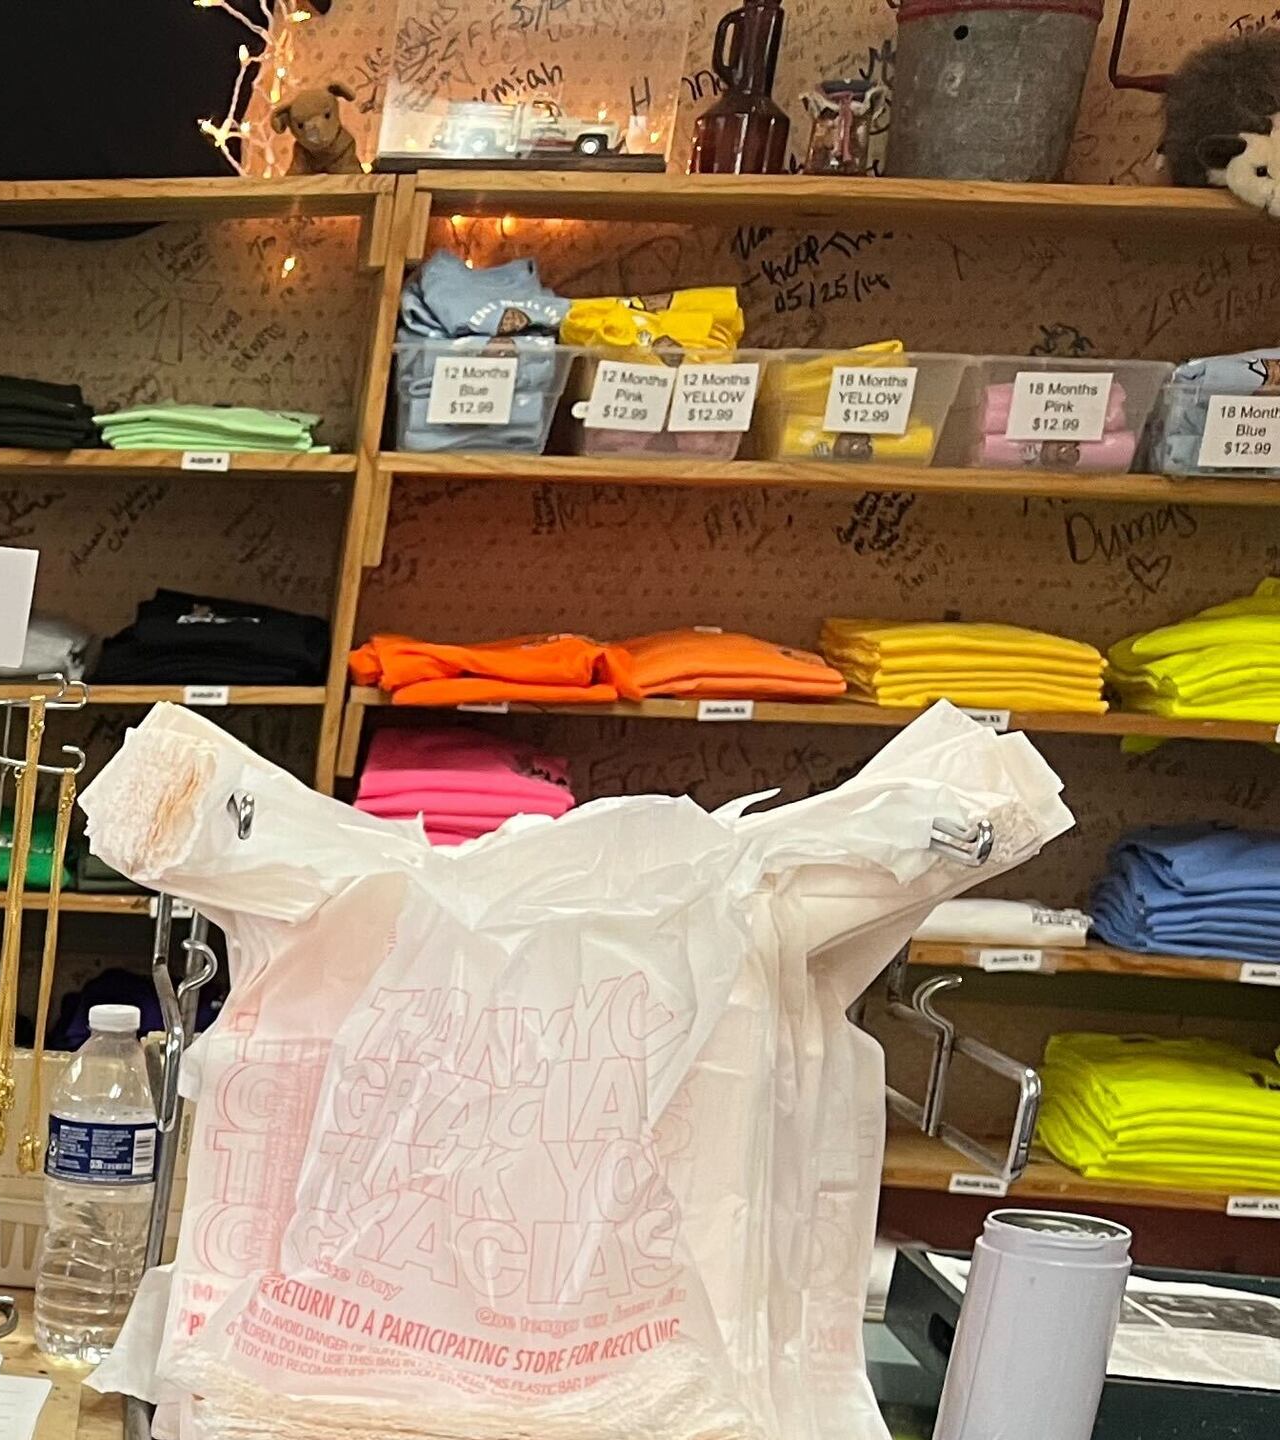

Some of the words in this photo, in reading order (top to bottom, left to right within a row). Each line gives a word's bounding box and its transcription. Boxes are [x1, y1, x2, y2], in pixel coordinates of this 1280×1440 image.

[443, 366, 460, 380] 12
[462, 366, 512, 381] Months
[601, 370, 619, 383] 12
[619, 370, 670, 389] Months
[682, 373, 699, 387] 12
[701, 373, 751, 388] Months
[838, 373, 855, 387] 18
[858, 373, 909, 388] Months
[459, 384, 490, 397] Blue
[614, 388, 644, 404] Pink
[682, 390, 746, 405] YELLOW
[1028, 382, 1044, 396] 18
[1047, 382, 1098, 397] Months
[838, 391, 902, 406] YELLOW
[1043, 399, 1075, 414] Pink
[449, 400, 495, 416] $12.99
[601, 403, 649, 422] $12.99
[687, 408, 734, 424] $12.99
[1219, 405, 1237, 420] 18
[842, 409, 890, 424] $12.99
[1031, 416, 1081, 432] $12.99
[1235, 423, 1267, 438] Blue
[1223, 441, 1272, 457] $12.99
[356, 1268, 404, 1303] Day
[257, 1307, 273, 1327] TO
[271, 1314, 305, 1339] AVOID
[304, 1326, 350, 1353] DANGER
[272, 1276, 336, 1322] RETURN
[339, 1298, 362, 1330] TO
[361, 1309, 374, 1337] A
[378, 1313, 510, 1368] PARTICIPATING
[512, 1348, 568, 1376] STORE
[566, 1339, 600, 1369] FOR
[261, 1349, 285, 1369] NOT
[297, 1342, 322, 1362] NOT
